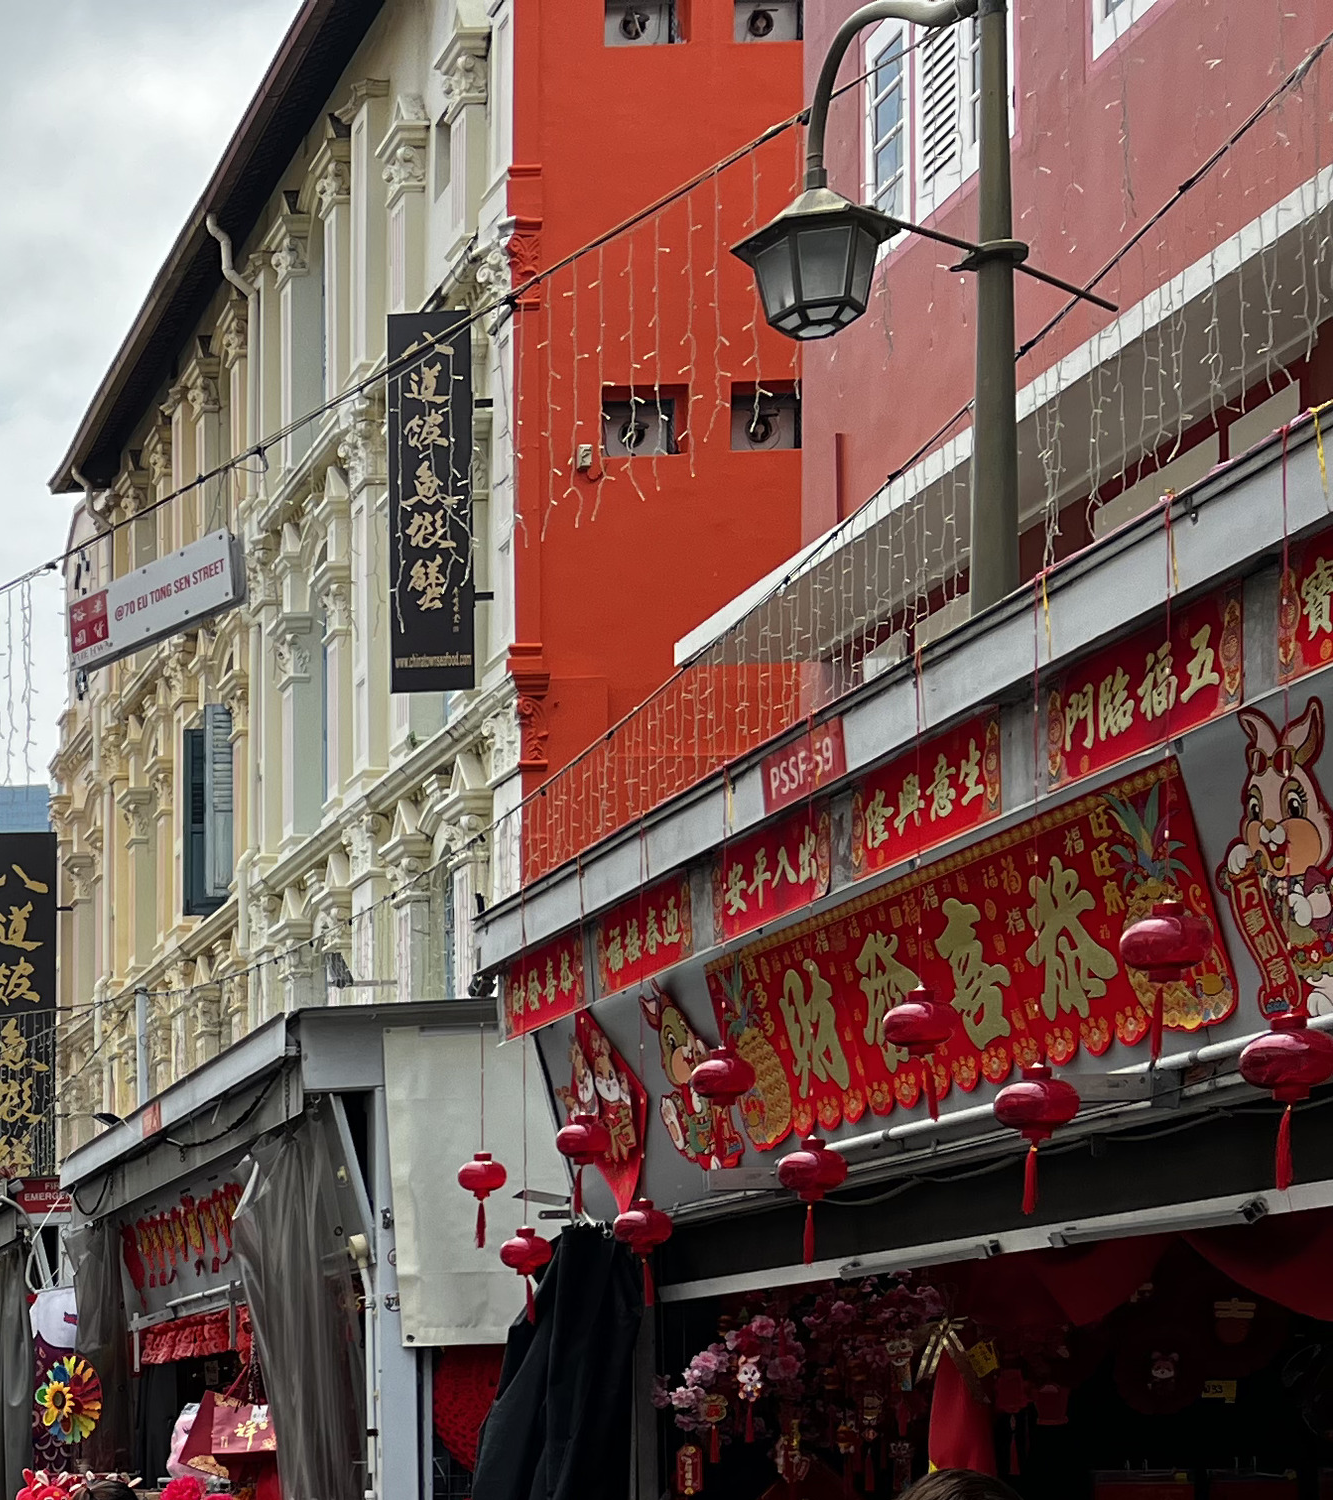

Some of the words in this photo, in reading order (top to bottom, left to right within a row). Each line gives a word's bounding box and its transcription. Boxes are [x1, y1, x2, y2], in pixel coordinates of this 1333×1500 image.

[115, 600, 135, 622] @70
[137, 596, 149, 612] EU
[149, 583, 173, 607] TONG
[174, 574, 191, 594] SEN
[192, 558, 225, 586] STREET
[24, 1191, 72, 1202] EMERGEN
